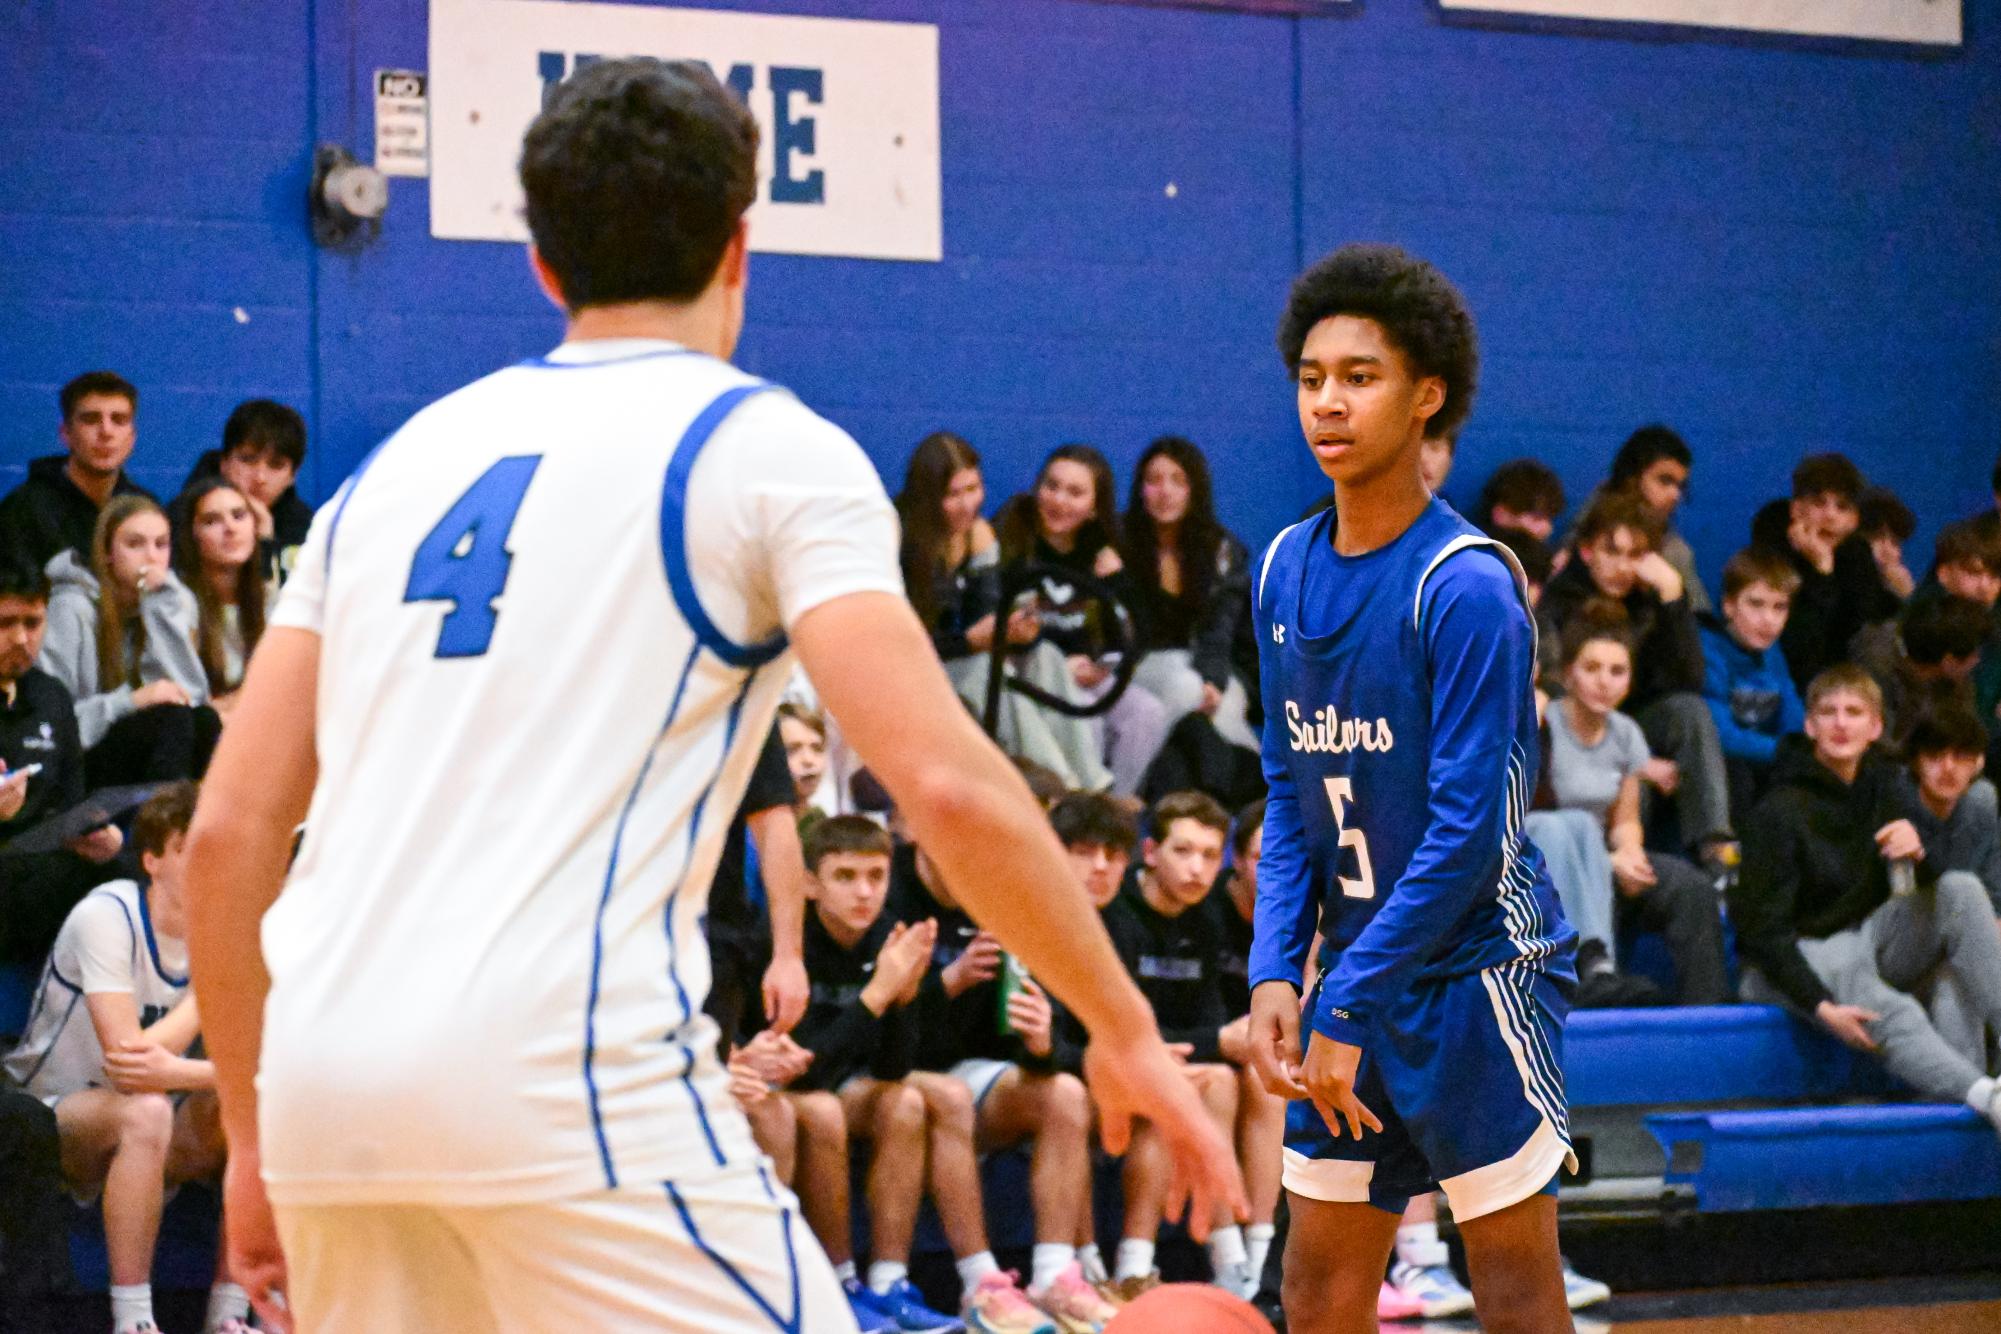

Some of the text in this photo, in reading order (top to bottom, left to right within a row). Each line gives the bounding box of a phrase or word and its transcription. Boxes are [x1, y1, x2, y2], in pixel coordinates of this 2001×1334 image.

[383, 77, 419, 97] NO
[402, 453, 543, 658] 4
[1285, 700, 1393, 753] Sailors
[1323, 777, 1376, 899] 5
